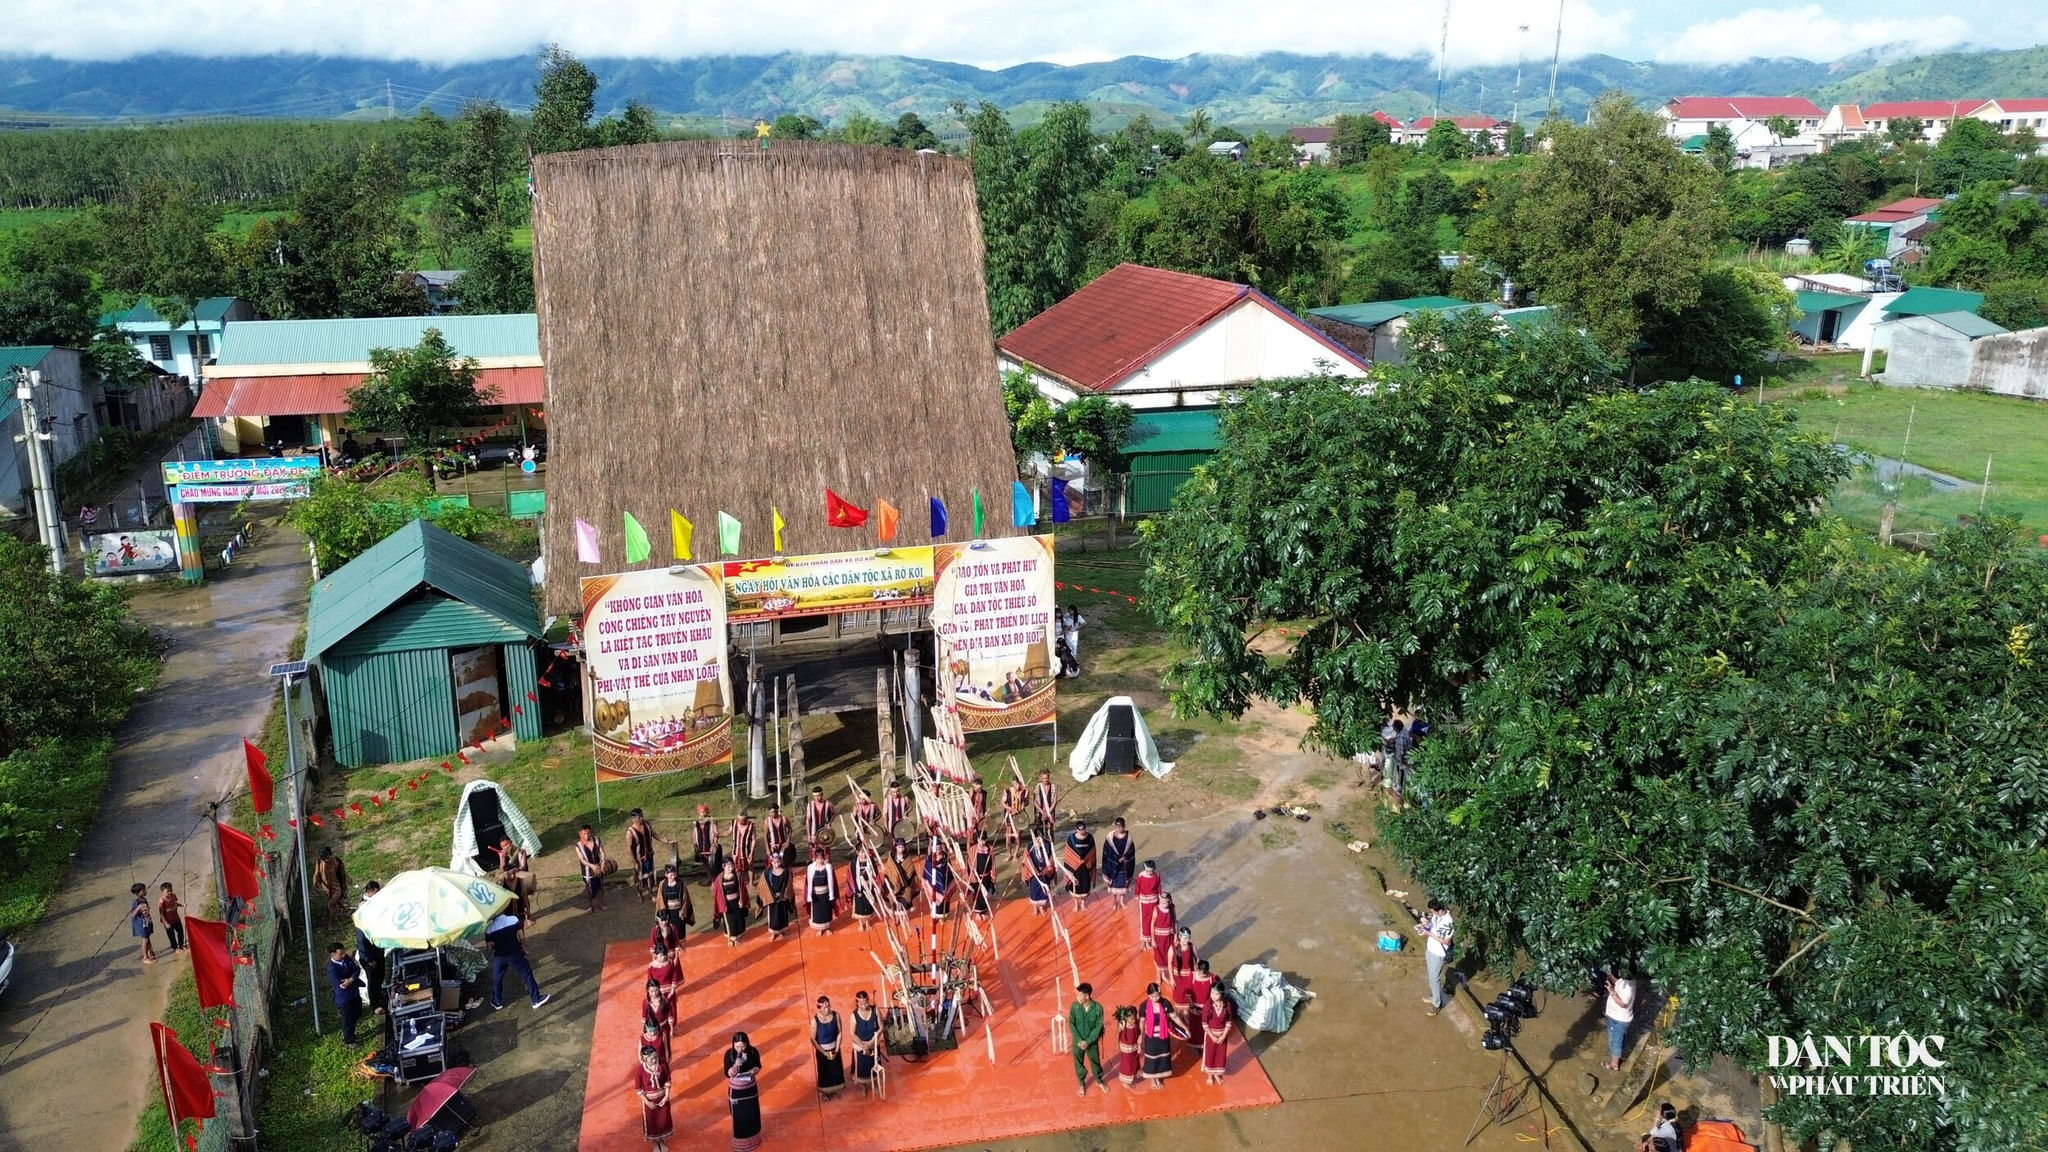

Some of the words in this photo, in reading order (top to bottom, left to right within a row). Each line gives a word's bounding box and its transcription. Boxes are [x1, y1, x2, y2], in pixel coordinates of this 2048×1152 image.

[973, 560, 989, 577] TỒN
[990, 561, 1000, 576] VÀ
[1002, 558, 1021, 575] PHÁT
[1023, 559, 1038, 572] HUY
[735, 578, 760, 593] NGÀY
[763, 576, 778, 593] HỘI
[781, 575, 800, 590] VĂN
[802, 573, 820, 588] HÓA
[822, 571, 840, 586] CÁC
[842, 569, 860, 585] DÂN
[862, 568, 879, 585] TỘC
[881, 566, 892, 581] XÃ
[965, 581, 978, 597] GIÁ
[994, 578, 1009, 594] VĂN
[1010, 578, 1025, 592] HÓA
[643, 594, 664, 610] GIAN
[666, 590, 683, 606] VĂN
[685, 588, 703, 604] HÓA
[970, 598, 986, 614] DÂN
[988, 596, 1002, 614] TỘC
[1004, 593, 1026, 610] THIỂU
[1027, 592, 1037, 607] SỐ
[598, 616, 623, 635] CỒNG
[625, 613, 658, 632] CHIÊNG
[660, 610, 676, 627] TÂY
[678, 606, 712, 625] NGUYÊN
[974, 616, 994, 631] PHÁT
[996, 611, 1018, 628] TRIỂN
[1019, 614, 1029, 626] DU
[1031, 612, 1048, 628] LỊCH
[600, 636, 612, 653] LÀ
[614, 635, 634, 654] KIỆT
[636, 632, 653, 650] TÁC
[655, 628, 688, 647] TRUYỀN
[690, 623, 712, 642] KHẨU
[984, 633, 1000, 648] BÀN
[1001, 631, 1012, 646] XÃ
[618, 654, 630, 671] VÀ
[632, 656, 642, 670] DI
[643, 651, 660, 668] SẢN
[661, 649, 679, 665] VĂN
[680, 647, 698, 663] HÓA
[634, 670, 651, 688] THỂ
[652, 669, 670, 686] CỦA
[671, 666, 695, 683] NHÂN
